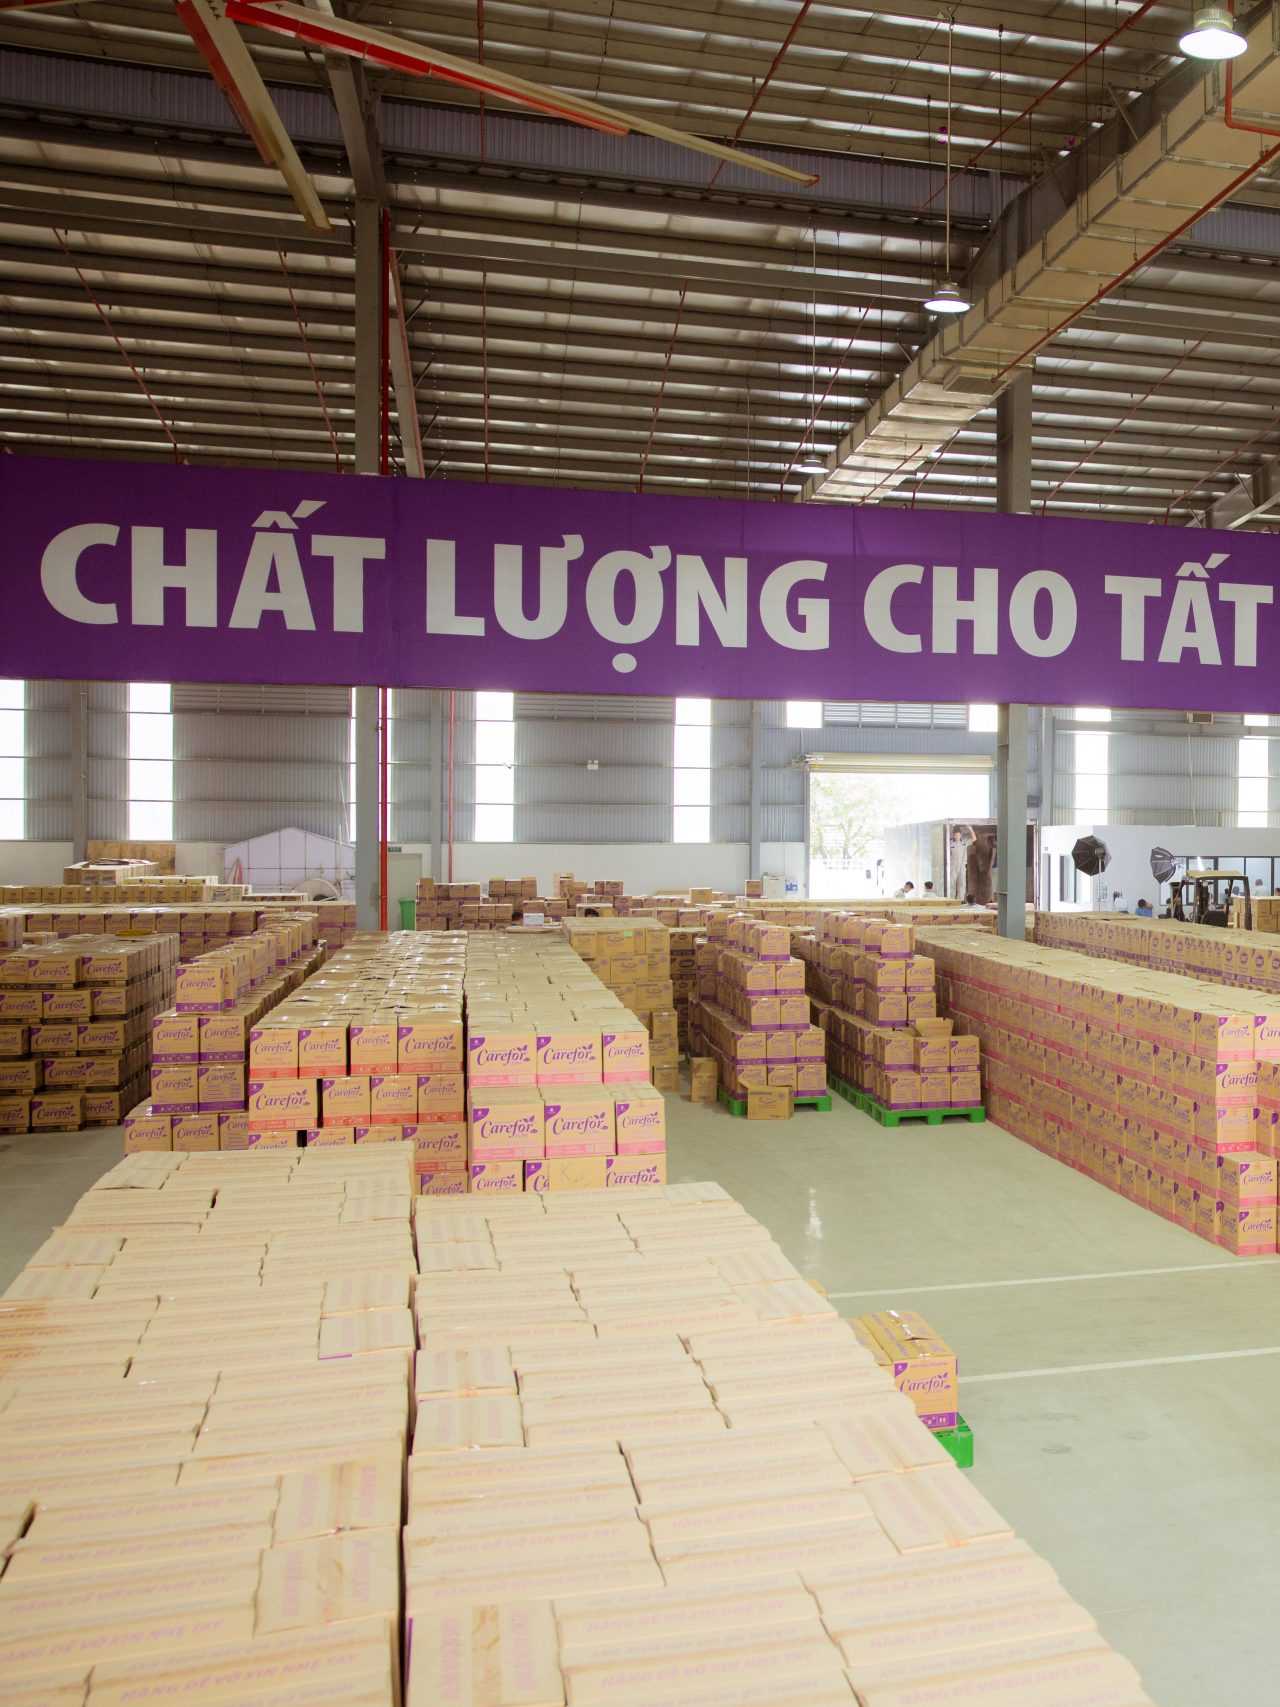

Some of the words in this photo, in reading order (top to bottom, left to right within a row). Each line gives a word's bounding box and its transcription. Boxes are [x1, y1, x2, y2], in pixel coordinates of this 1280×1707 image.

[40, 500, 386, 632] CHẤT
[426, 534, 830, 674] LƯỢNG
[864, 564, 1077, 658] CHO
[1105, 554, 1274, 667] TẤT
[405, 1037, 452, 1054] Carefor
[477, 1049, 525, 1066] Carefor
[543, 1048, 591, 1065] Carefor
[256, 1092, 305, 1110] Carefor
[480, 1120, 532, 1139] Carefor
[552, 1117, 602, 1136] Carefor
[900, 1373, 946, 1395] Carefor
